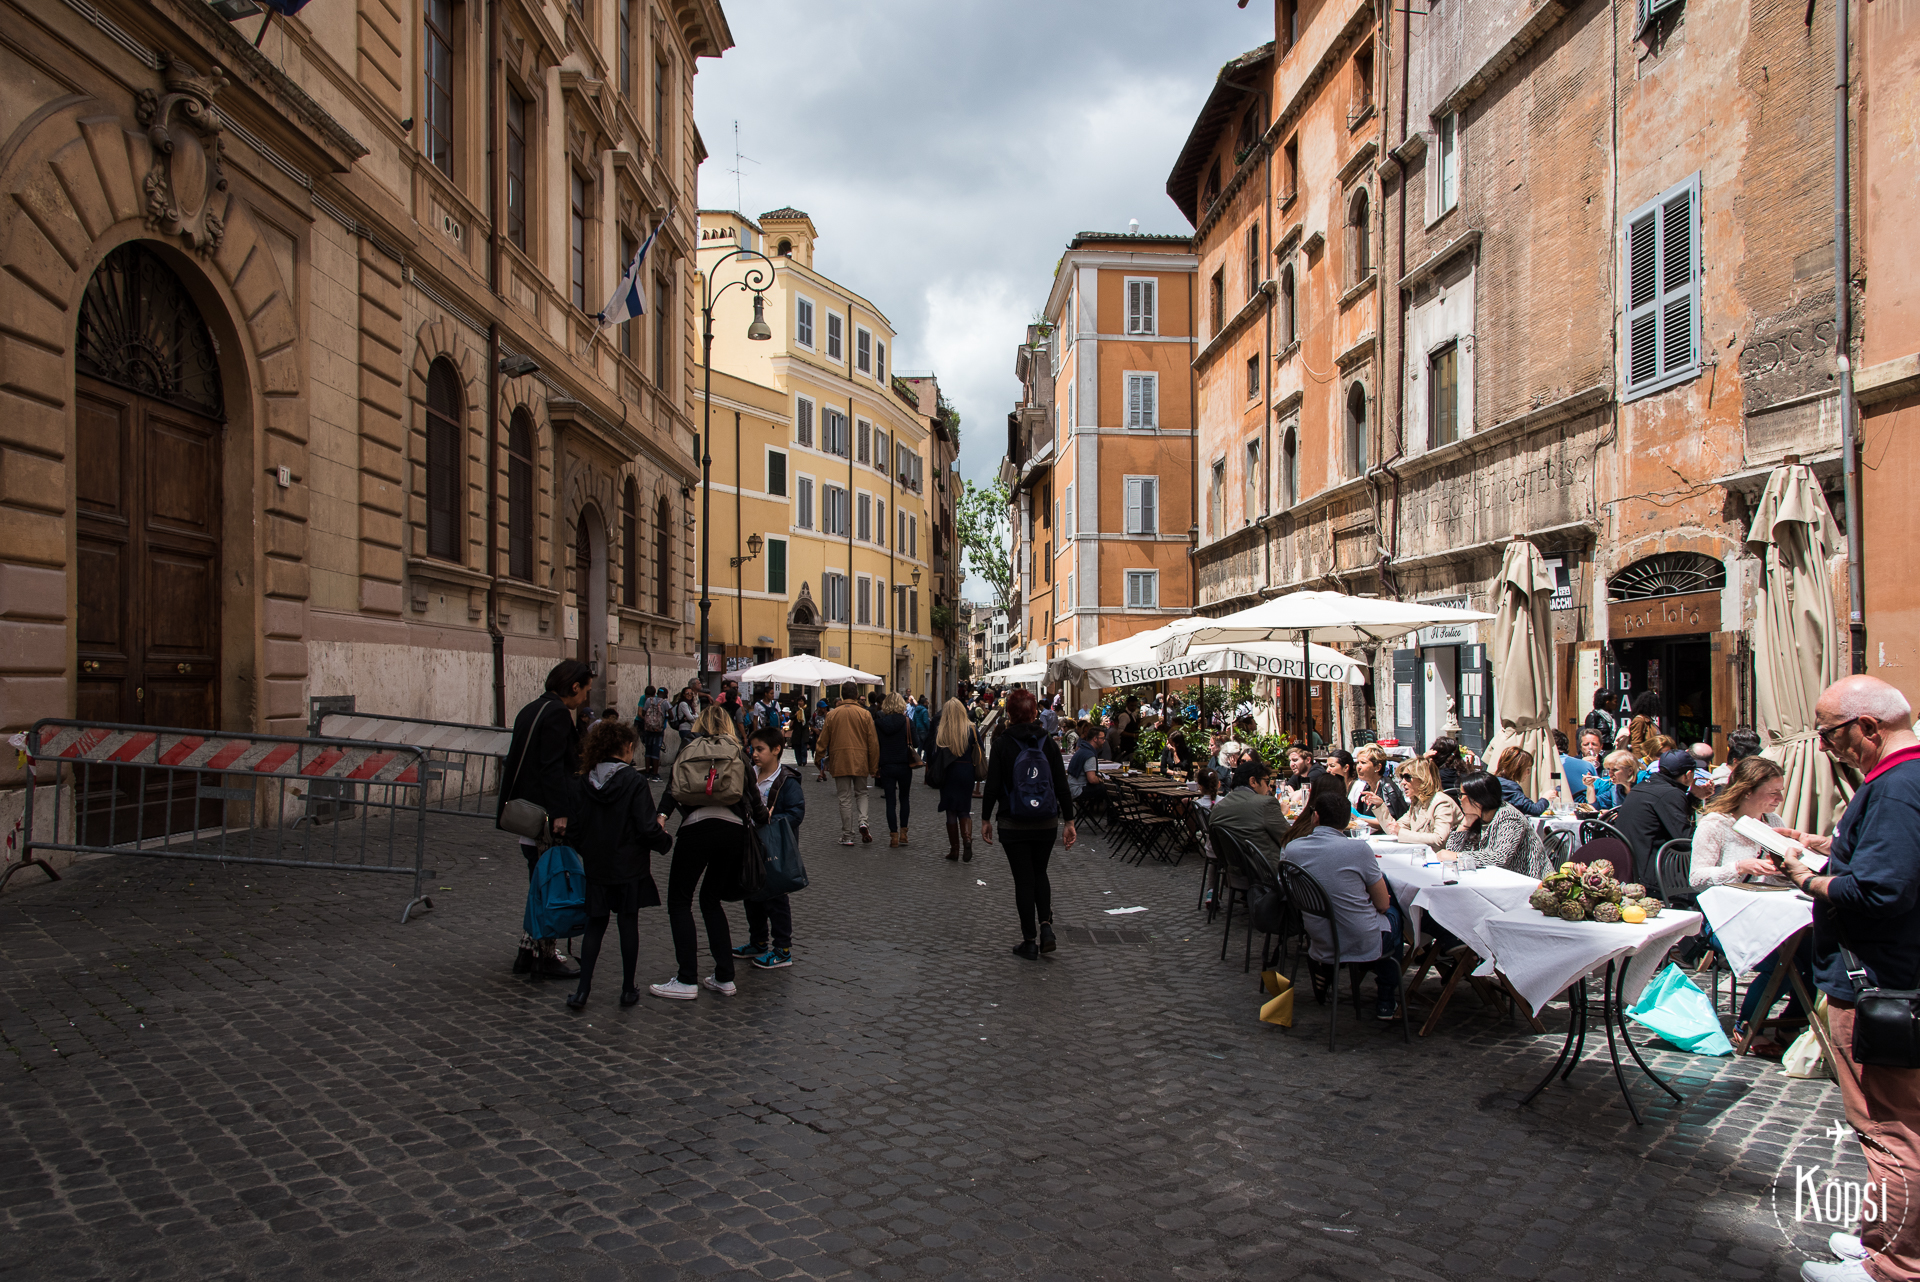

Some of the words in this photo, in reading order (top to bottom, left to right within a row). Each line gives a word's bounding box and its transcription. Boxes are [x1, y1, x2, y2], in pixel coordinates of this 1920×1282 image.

[281, 469, 289, 483] 71
[1624, 608, 1653, 635] Bar
[1430, 626, 1439, 639] Il
[1439, 625, 1462, 639] Portico
[1110, 658, 1209, 686] Ristorante
[1233, 652, 1250, 670] IL
[1256, 655, 1344, 681] PORTICO
